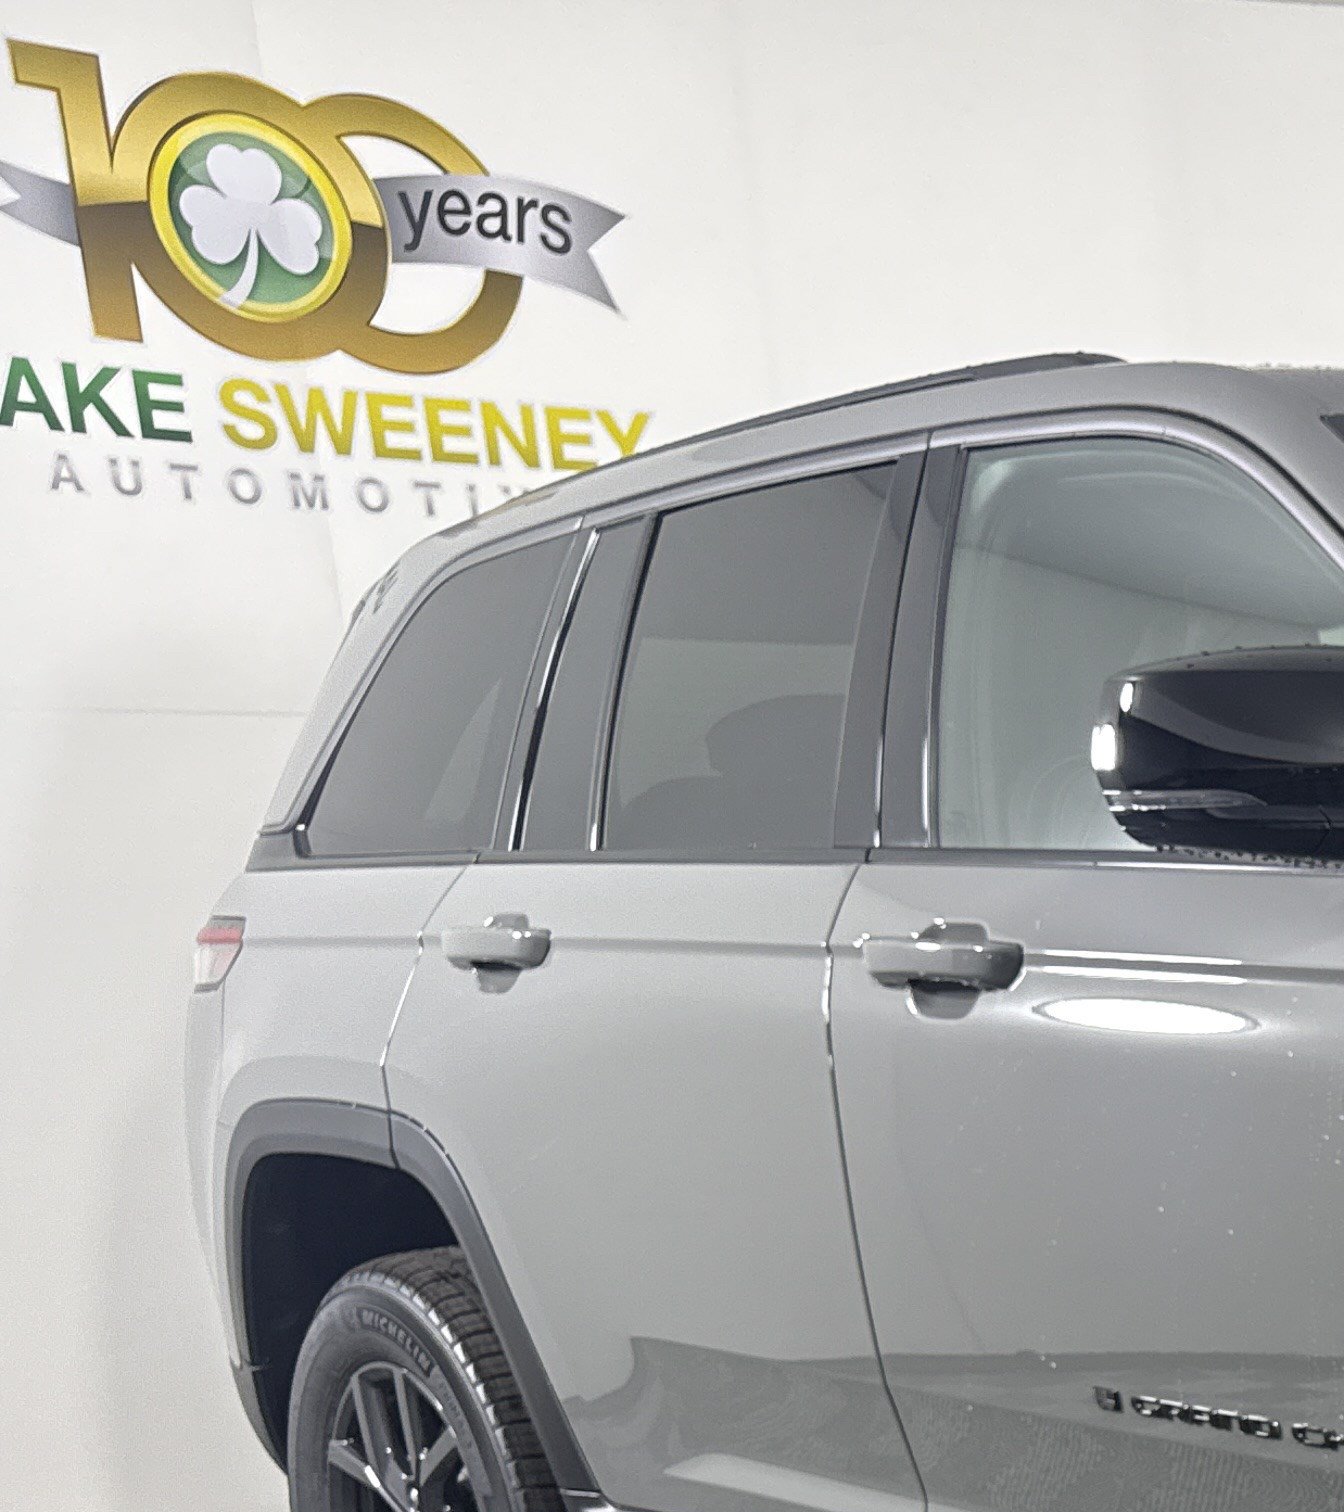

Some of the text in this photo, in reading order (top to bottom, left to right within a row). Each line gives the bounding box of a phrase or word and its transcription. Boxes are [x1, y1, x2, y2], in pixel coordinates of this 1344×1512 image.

[398, 187, 572, 255] years
[0, 356, 651, 471] AKE SWEENEY
[50, 452, 531, 518] AUTOMOTI
[1131, 1394, 1282, 1441] GRAND
